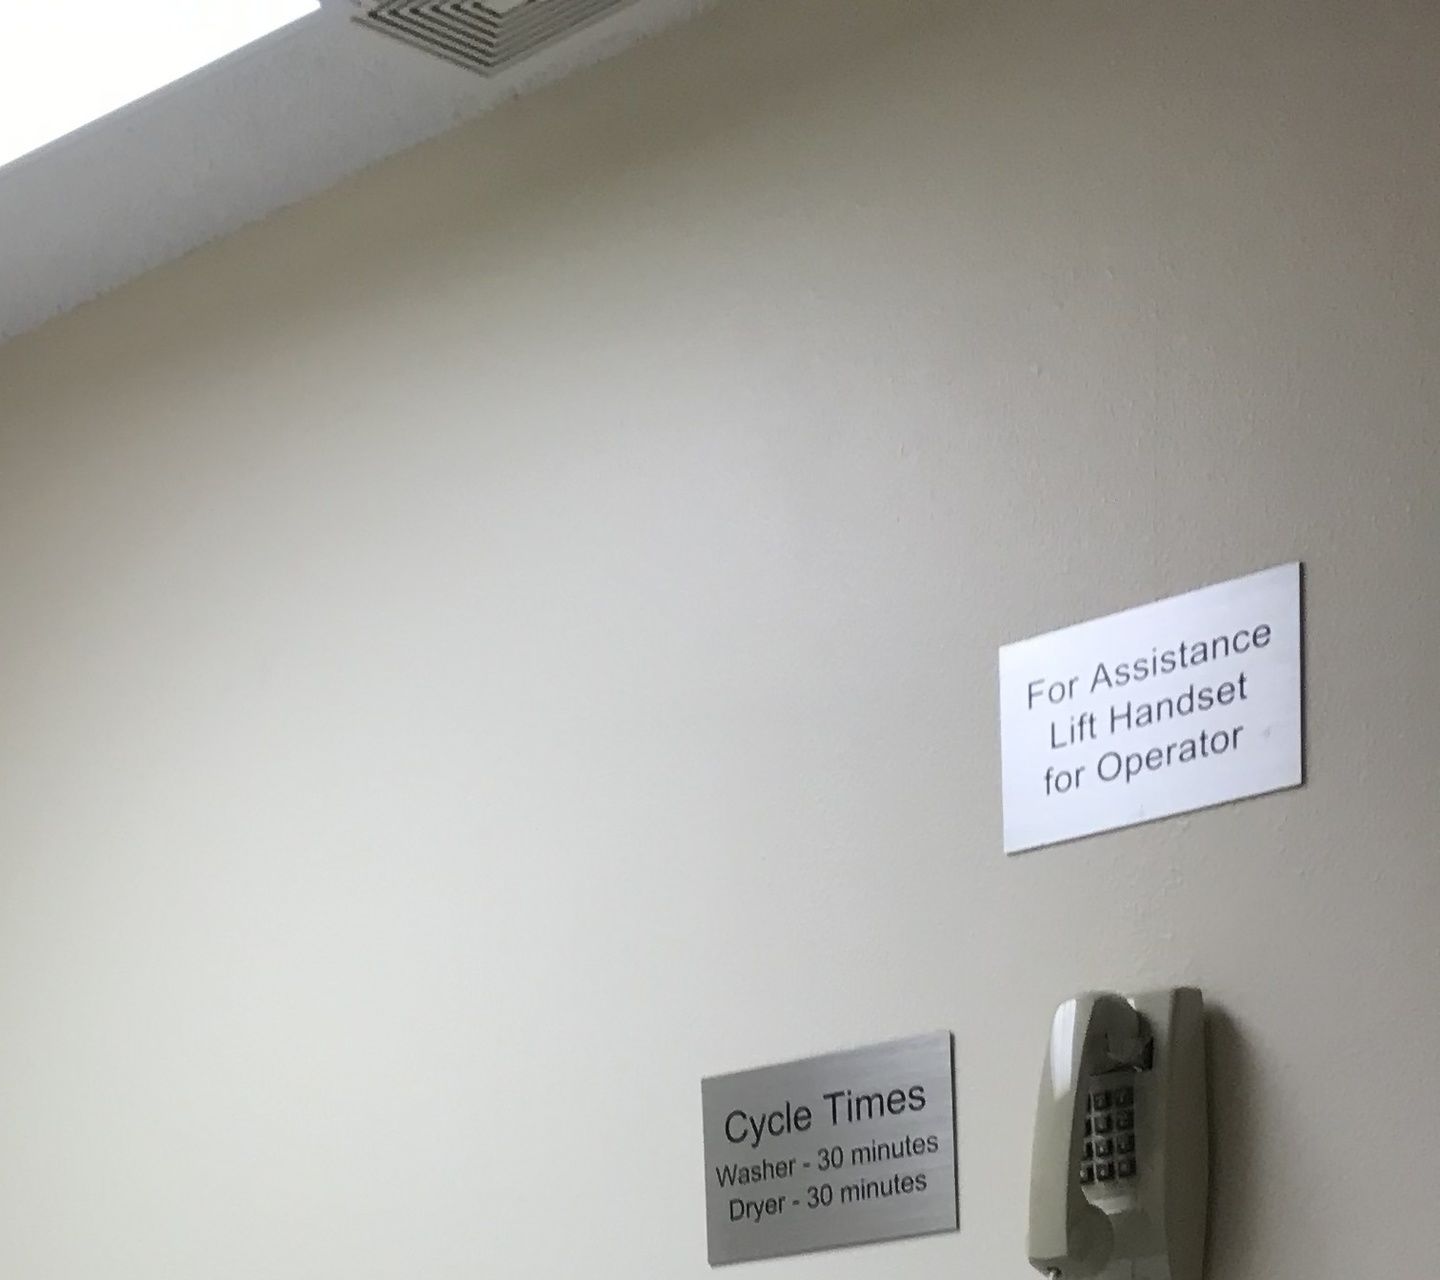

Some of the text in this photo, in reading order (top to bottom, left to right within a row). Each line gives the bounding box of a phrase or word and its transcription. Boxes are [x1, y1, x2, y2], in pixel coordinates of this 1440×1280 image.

[1028, 623, 1271, 709] For Assistance
[1050, 672, 1248, 749] Lift Handset
[1044, 725, 1244, 796] for Operator
[725, 1084, 926, 1148] Cycle Times
[716, 1157, 796, 1188] Washer
[817, 1146, 844, 1172] 30
[851, 1134, 939, 1165] minutes
[729, 1196, 786, 1223] Dryer
[807, 1183, 833, 1209] 30
[840, 1173, 928, 1204] minutes
